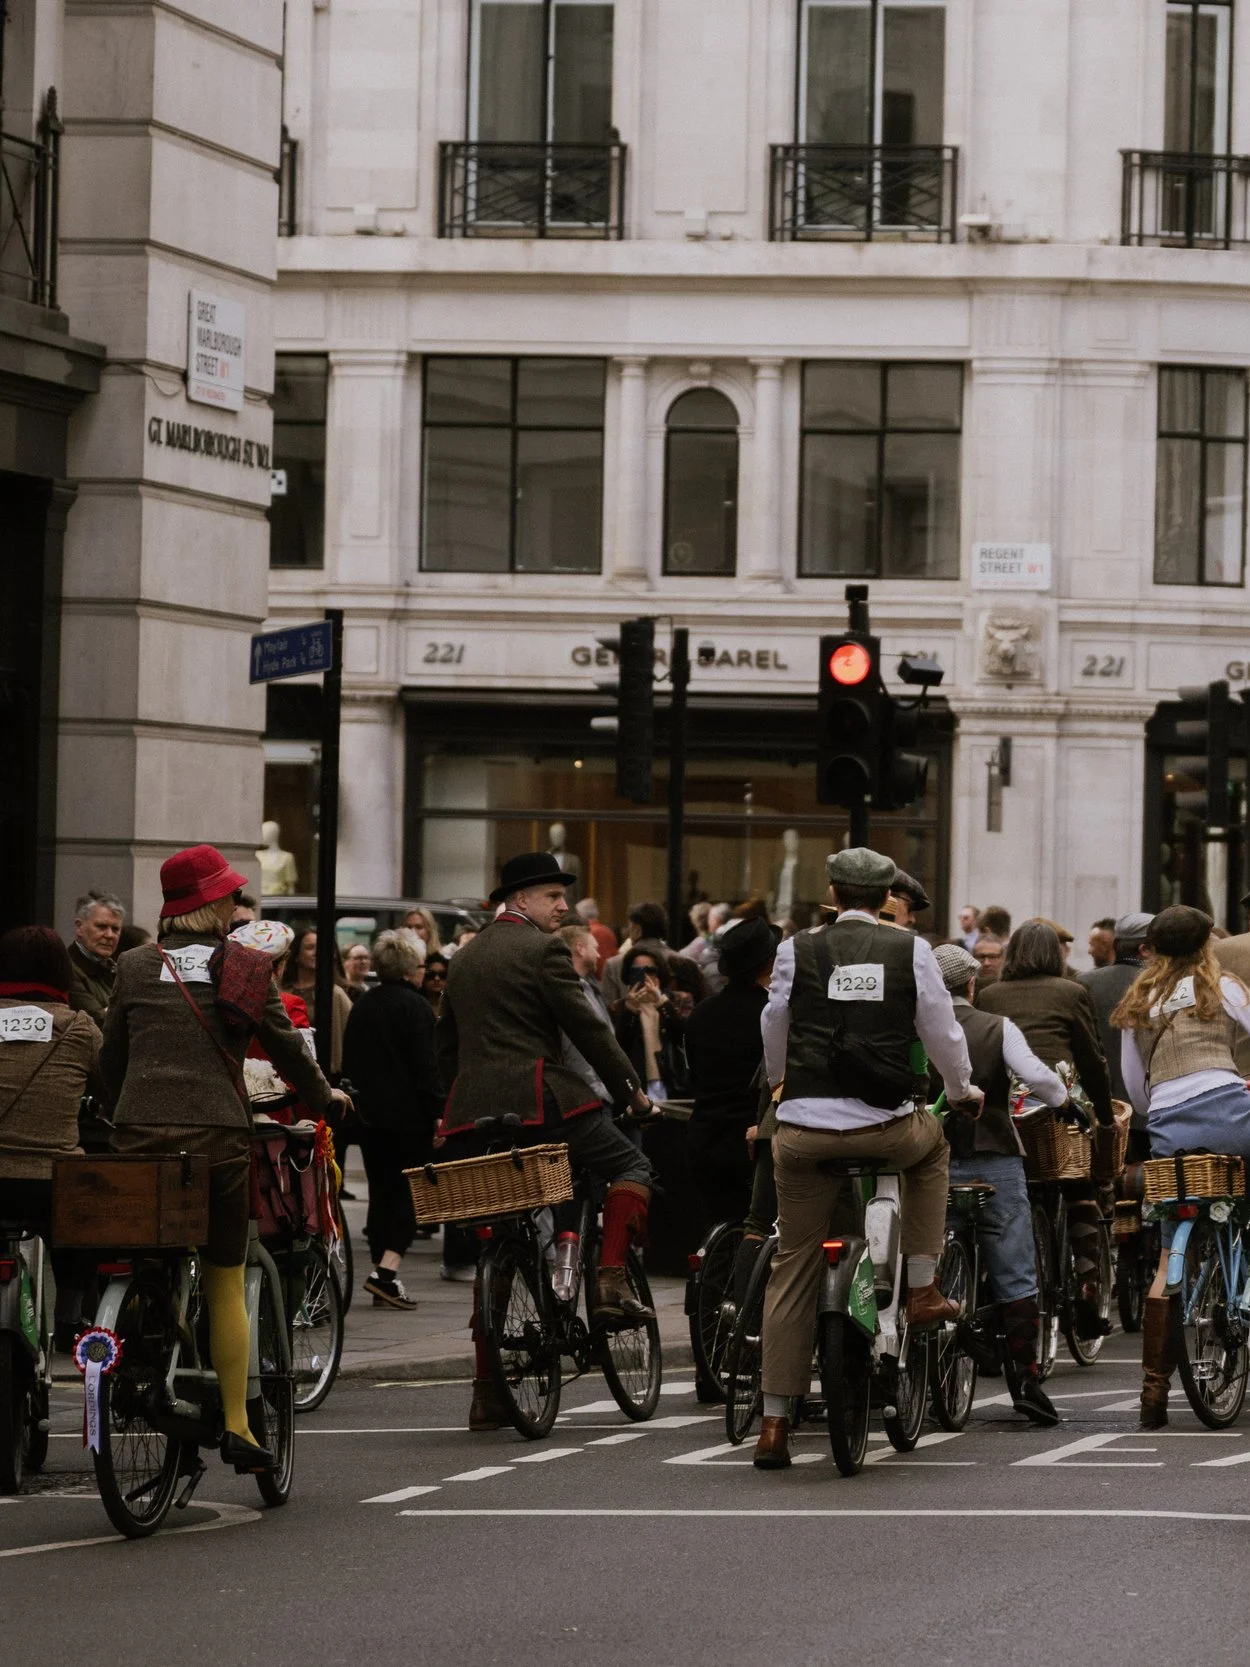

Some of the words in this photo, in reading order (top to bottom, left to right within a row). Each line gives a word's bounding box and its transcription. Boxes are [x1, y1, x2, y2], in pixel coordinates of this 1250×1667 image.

[198, 300, 217, 324] GREAT
[197, 352, 219, 376] STREET
[165, 420, 241, 463] MARLBOROUGH
[979, 548, 1025, 559] REGENT
[979, 562, 1023, 574] STREET
[423, 641, 466, 664] 221
[1081, 654, 1126, 677] 221
[835, 976, 878, 992] 1229
[2, 1017, 47, 1032] 1230
[87, 1375, 97, 1438] CORDINGS
